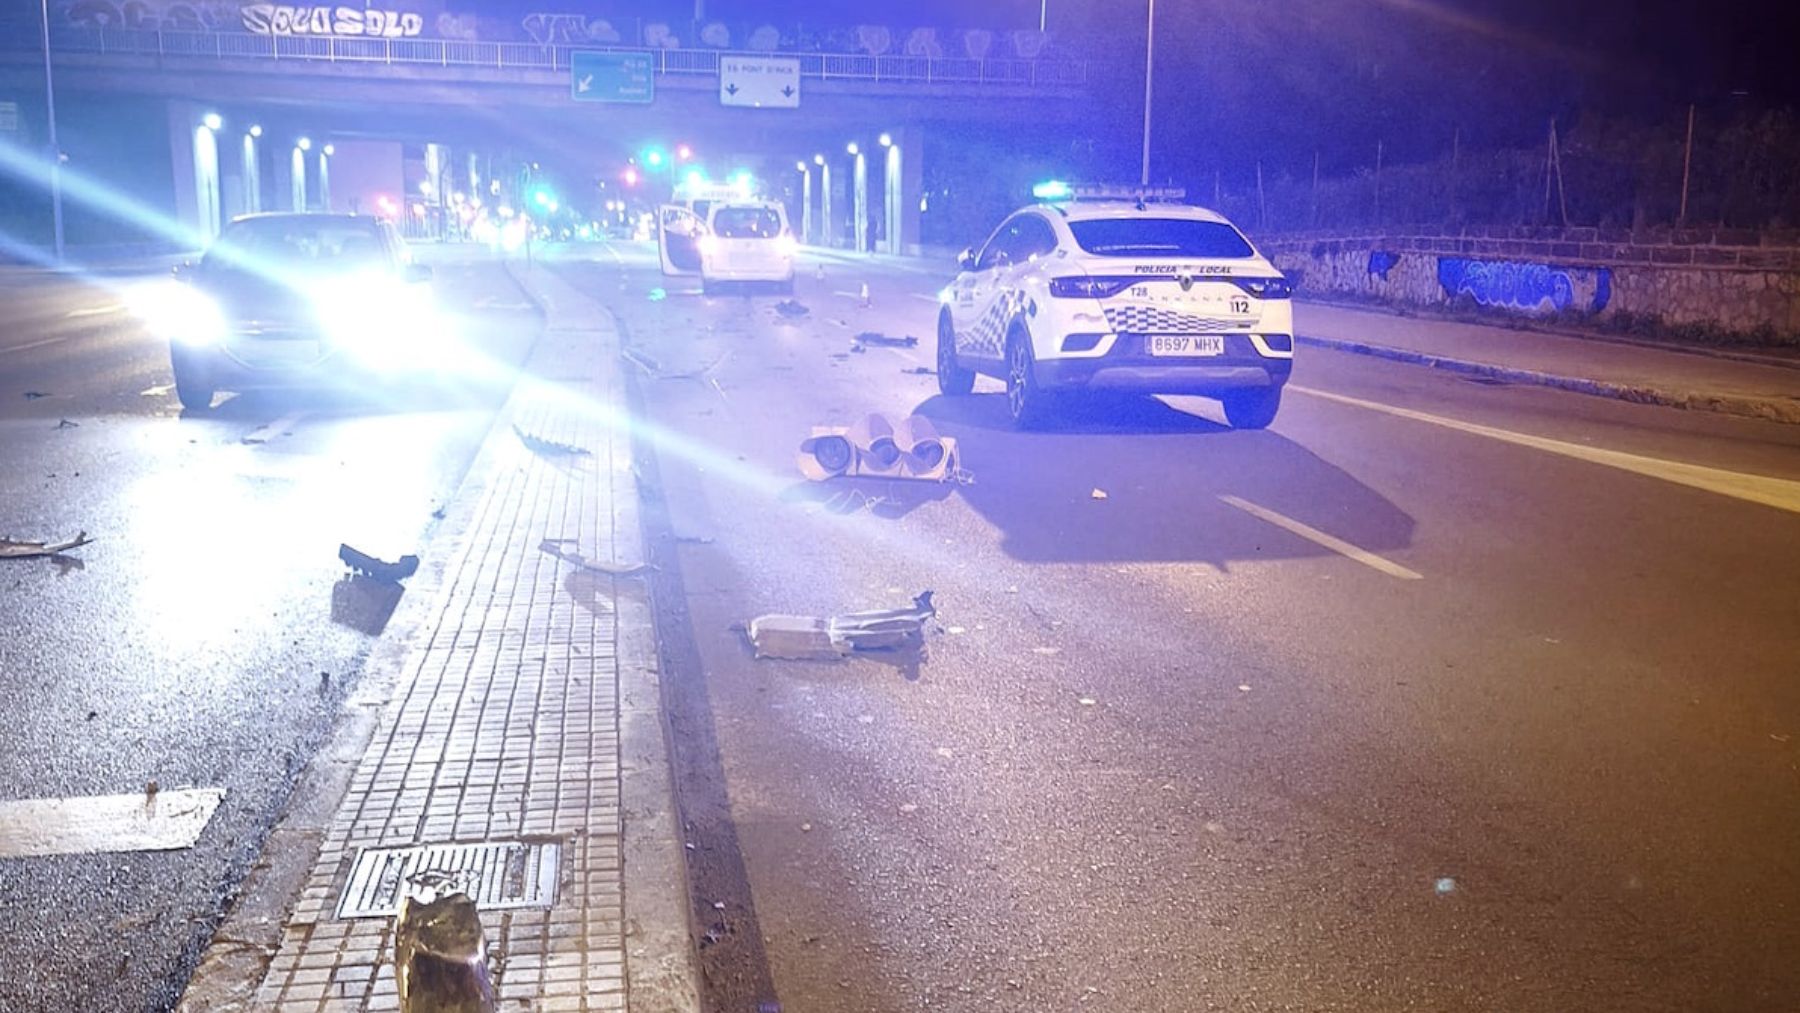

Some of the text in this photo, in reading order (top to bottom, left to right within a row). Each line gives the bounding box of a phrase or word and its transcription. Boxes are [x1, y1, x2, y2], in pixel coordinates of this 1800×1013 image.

[1135, 265, 1232, 274] POLICIA LOCAL
[1230, 301, 1249, 313] 112
[1154, 337, 1221, 351] 8697 MHX
